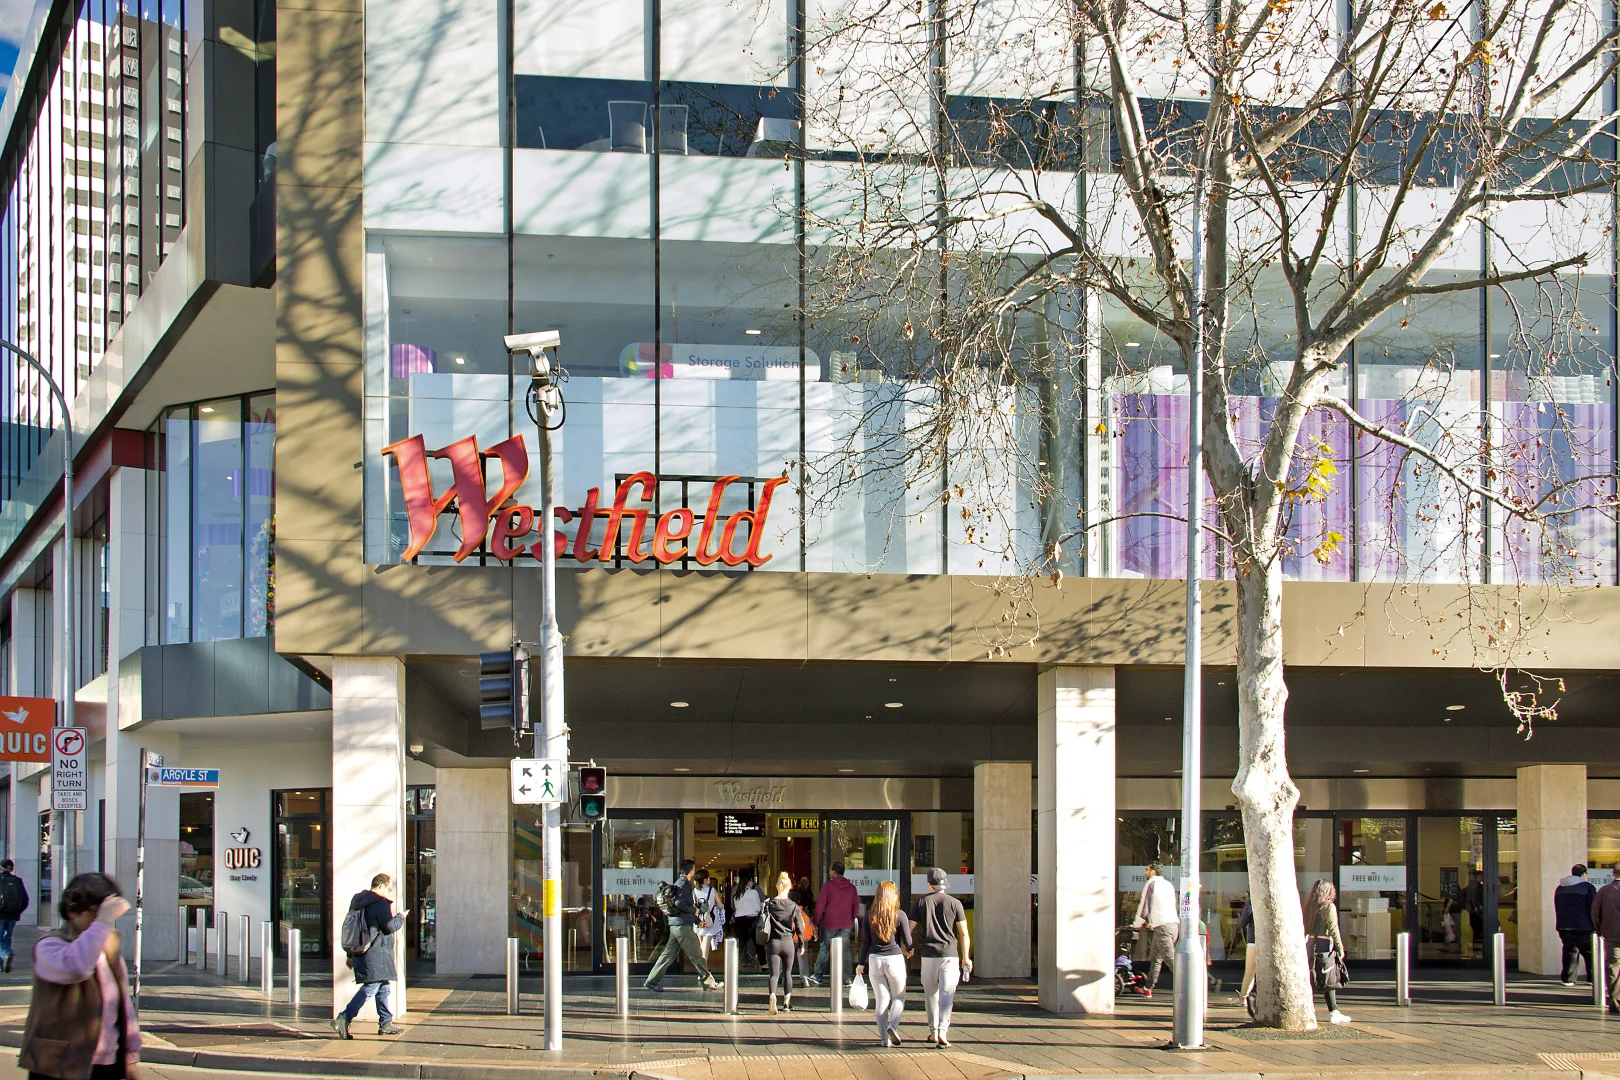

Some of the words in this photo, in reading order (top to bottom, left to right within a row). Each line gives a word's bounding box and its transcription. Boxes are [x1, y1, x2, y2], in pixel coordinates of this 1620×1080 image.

[689, 355, 740, 370] Storage
[381, 433, 789, 567] Westfield
[60, 759, 79, 769] NO
[163, 769, 196, 781] ARGYLE
[198, 771, 209, 781] ST
[714, 781, 787, 804] Westfield
[783, 819, 798, 829] CITY
[224, 848, 262, 869] QUIC
[616, 878, 631, 886] FREE
[632, 878, 646, 886] WIFI
[860, 879, 873, 887] WIFI
[1131, 875, 1146, 883] FREE
